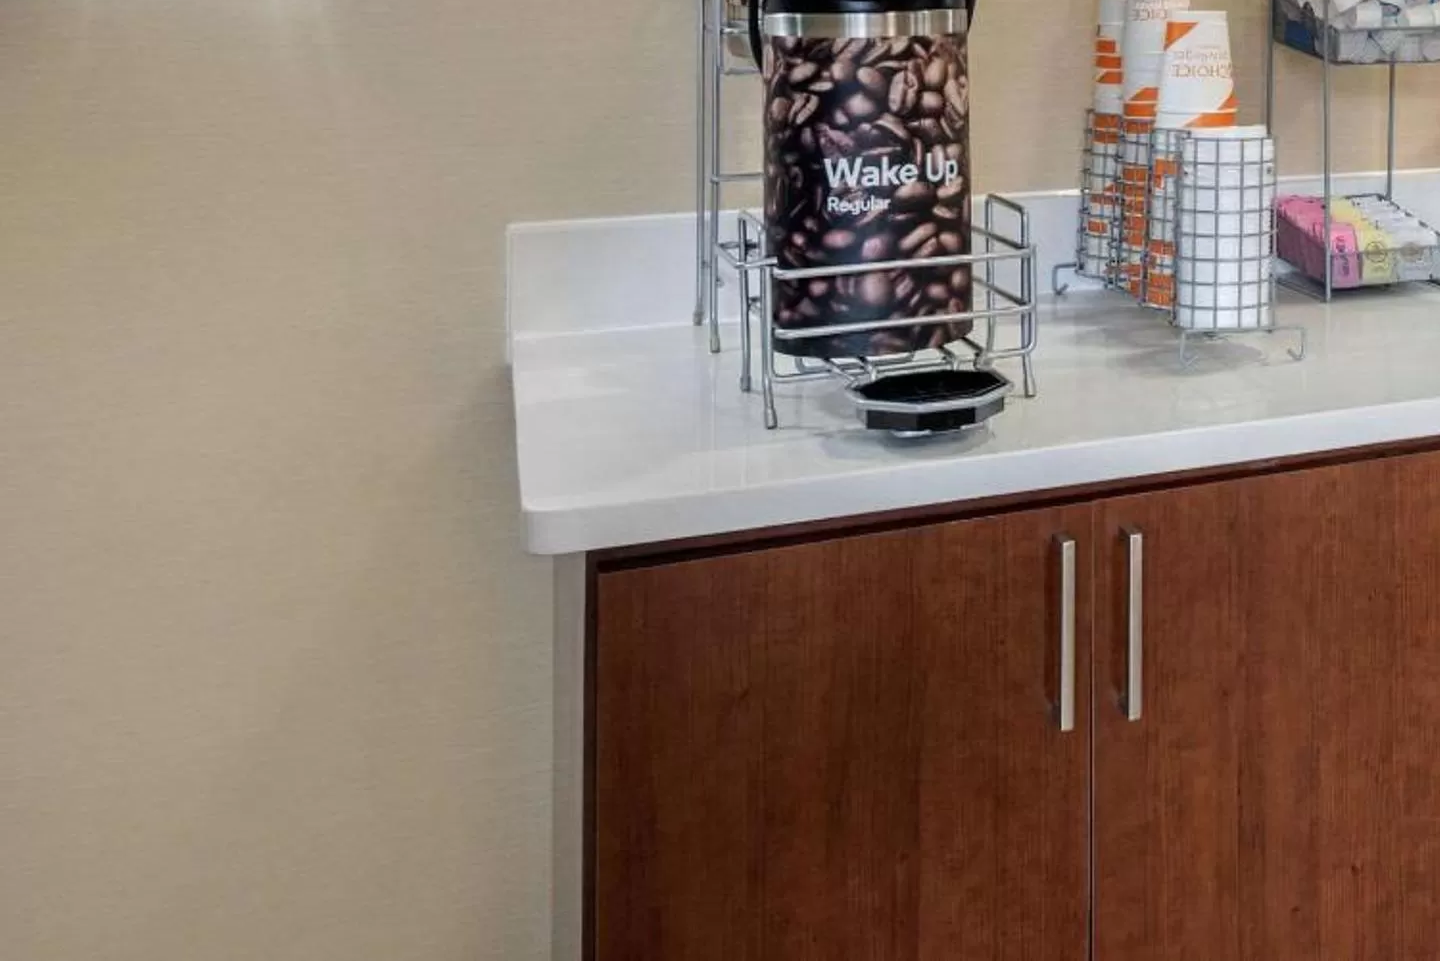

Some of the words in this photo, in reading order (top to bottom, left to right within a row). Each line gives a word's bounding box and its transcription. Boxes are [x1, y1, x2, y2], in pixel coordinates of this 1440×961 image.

[824, 156, 918, 188] Wake
[926, 152, 958, 187] Up
[827, 195, 891, 215] Regular
